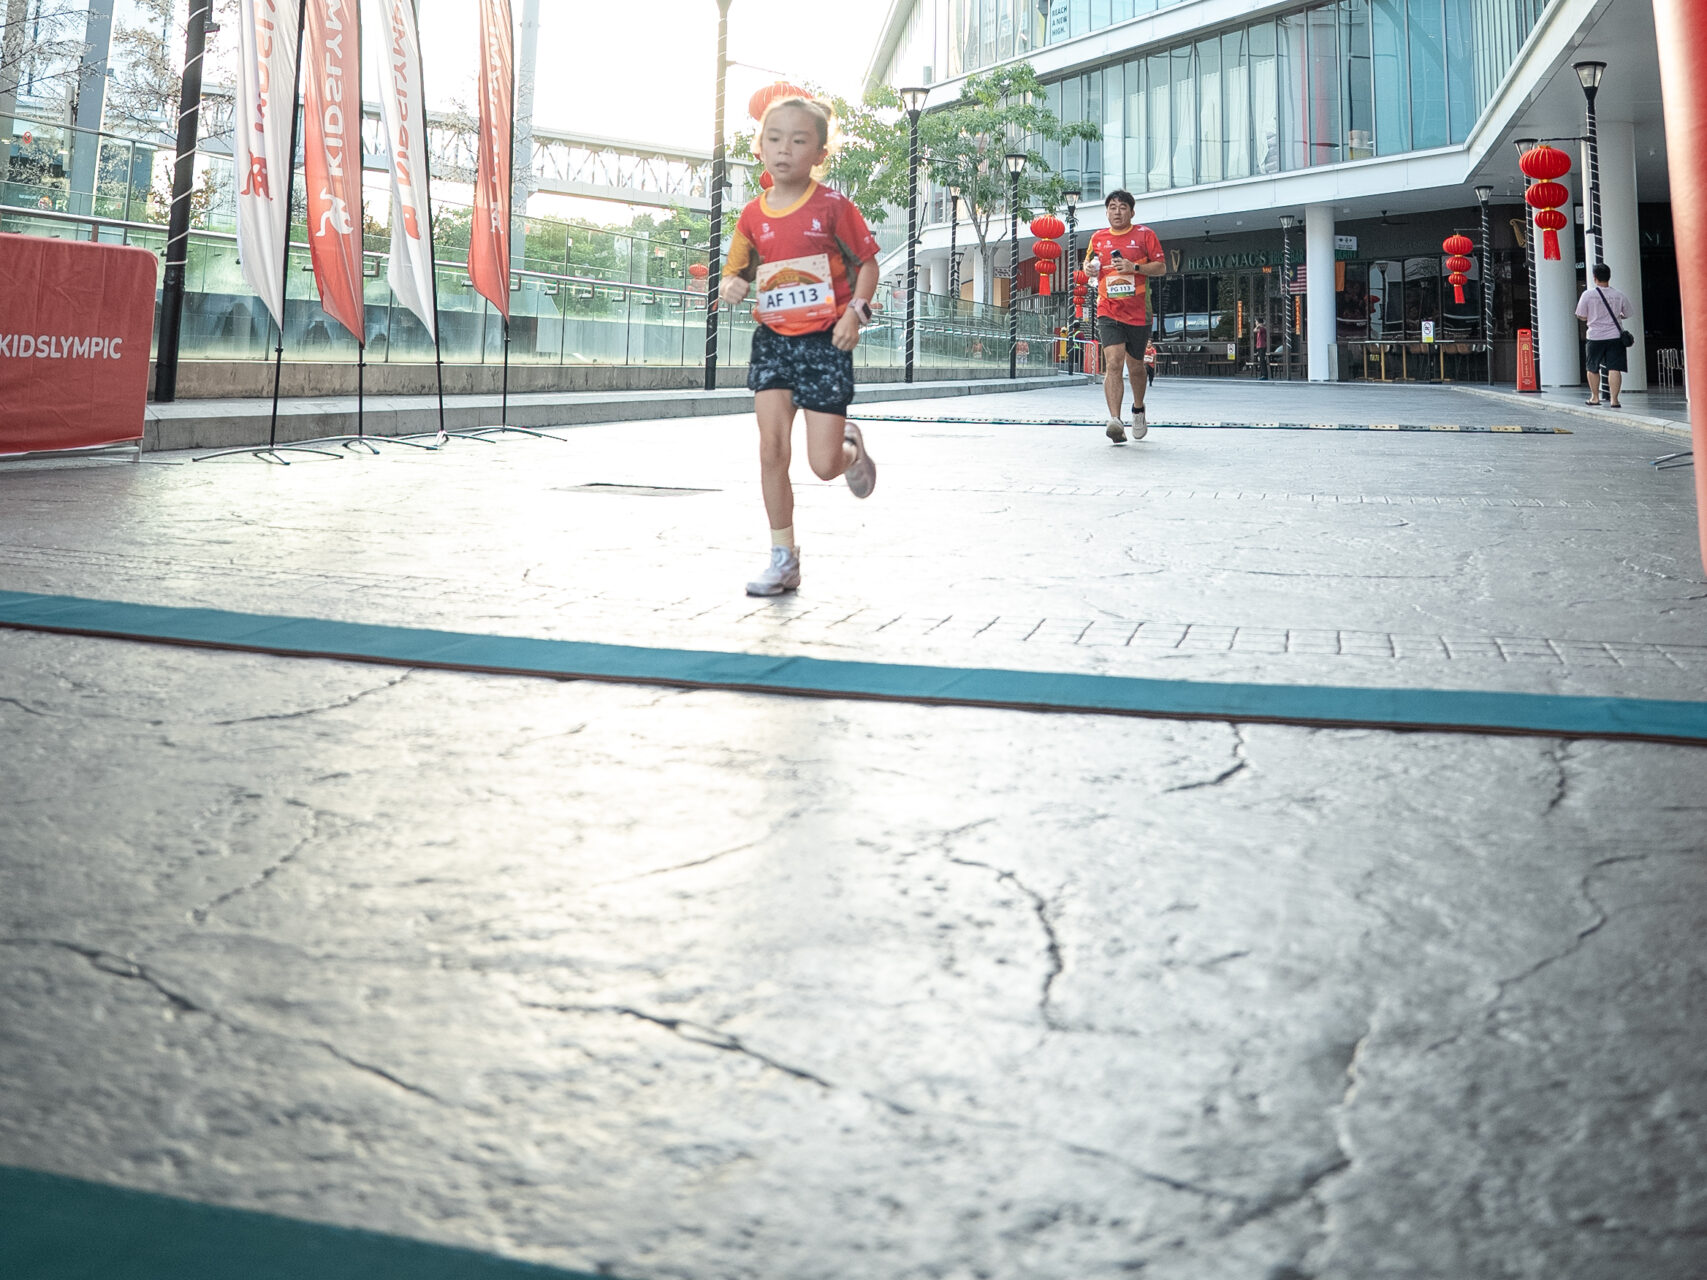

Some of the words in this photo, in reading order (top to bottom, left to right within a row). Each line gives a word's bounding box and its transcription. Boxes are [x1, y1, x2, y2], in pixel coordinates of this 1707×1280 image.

[1188, 255, 1224, 270] HEALY
[1231, 251, 1266, 267] MAC'S
[766, 292, 784, 308] AF
[789, 288, 819, 305] 113
[0, 333, 123, 360] KIDSLYMPIC
